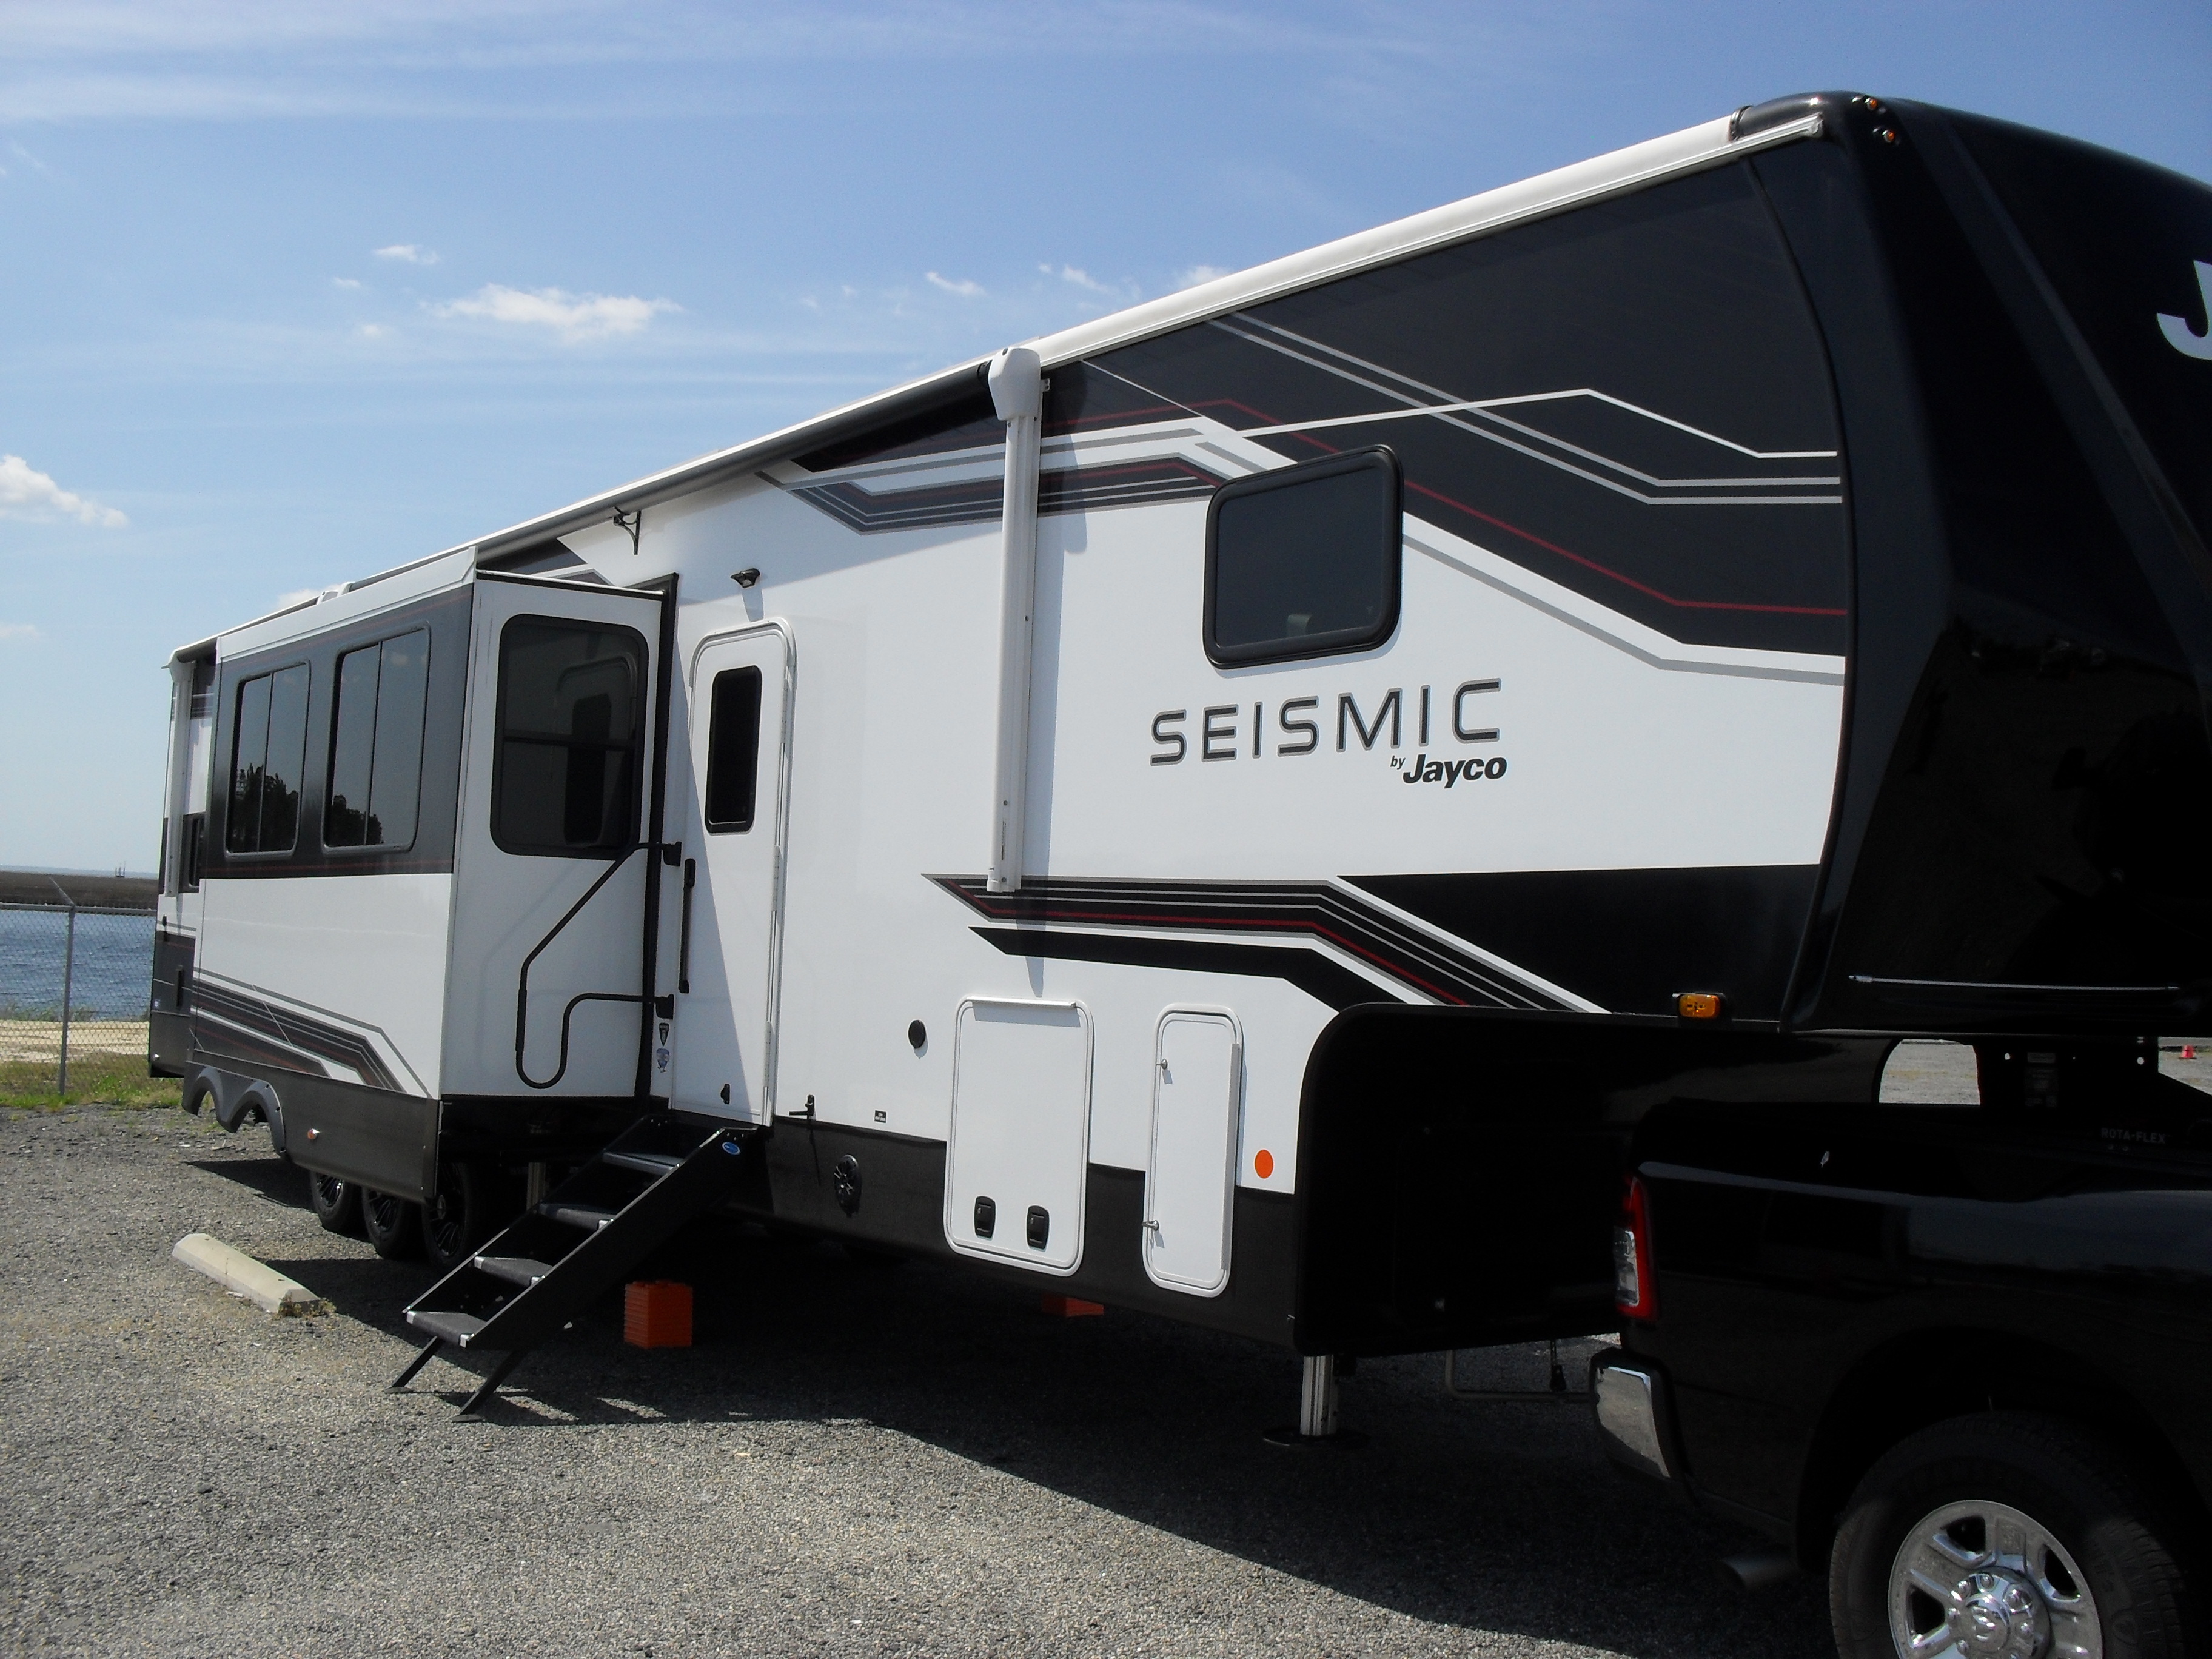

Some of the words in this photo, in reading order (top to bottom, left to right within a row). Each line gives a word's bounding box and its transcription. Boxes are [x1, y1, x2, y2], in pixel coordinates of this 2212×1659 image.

[1150, 678, 1501, 766] SEISMIC
[1390, 756, 1406, 770] by
[1403, 754, 1507, 789] Jayco
